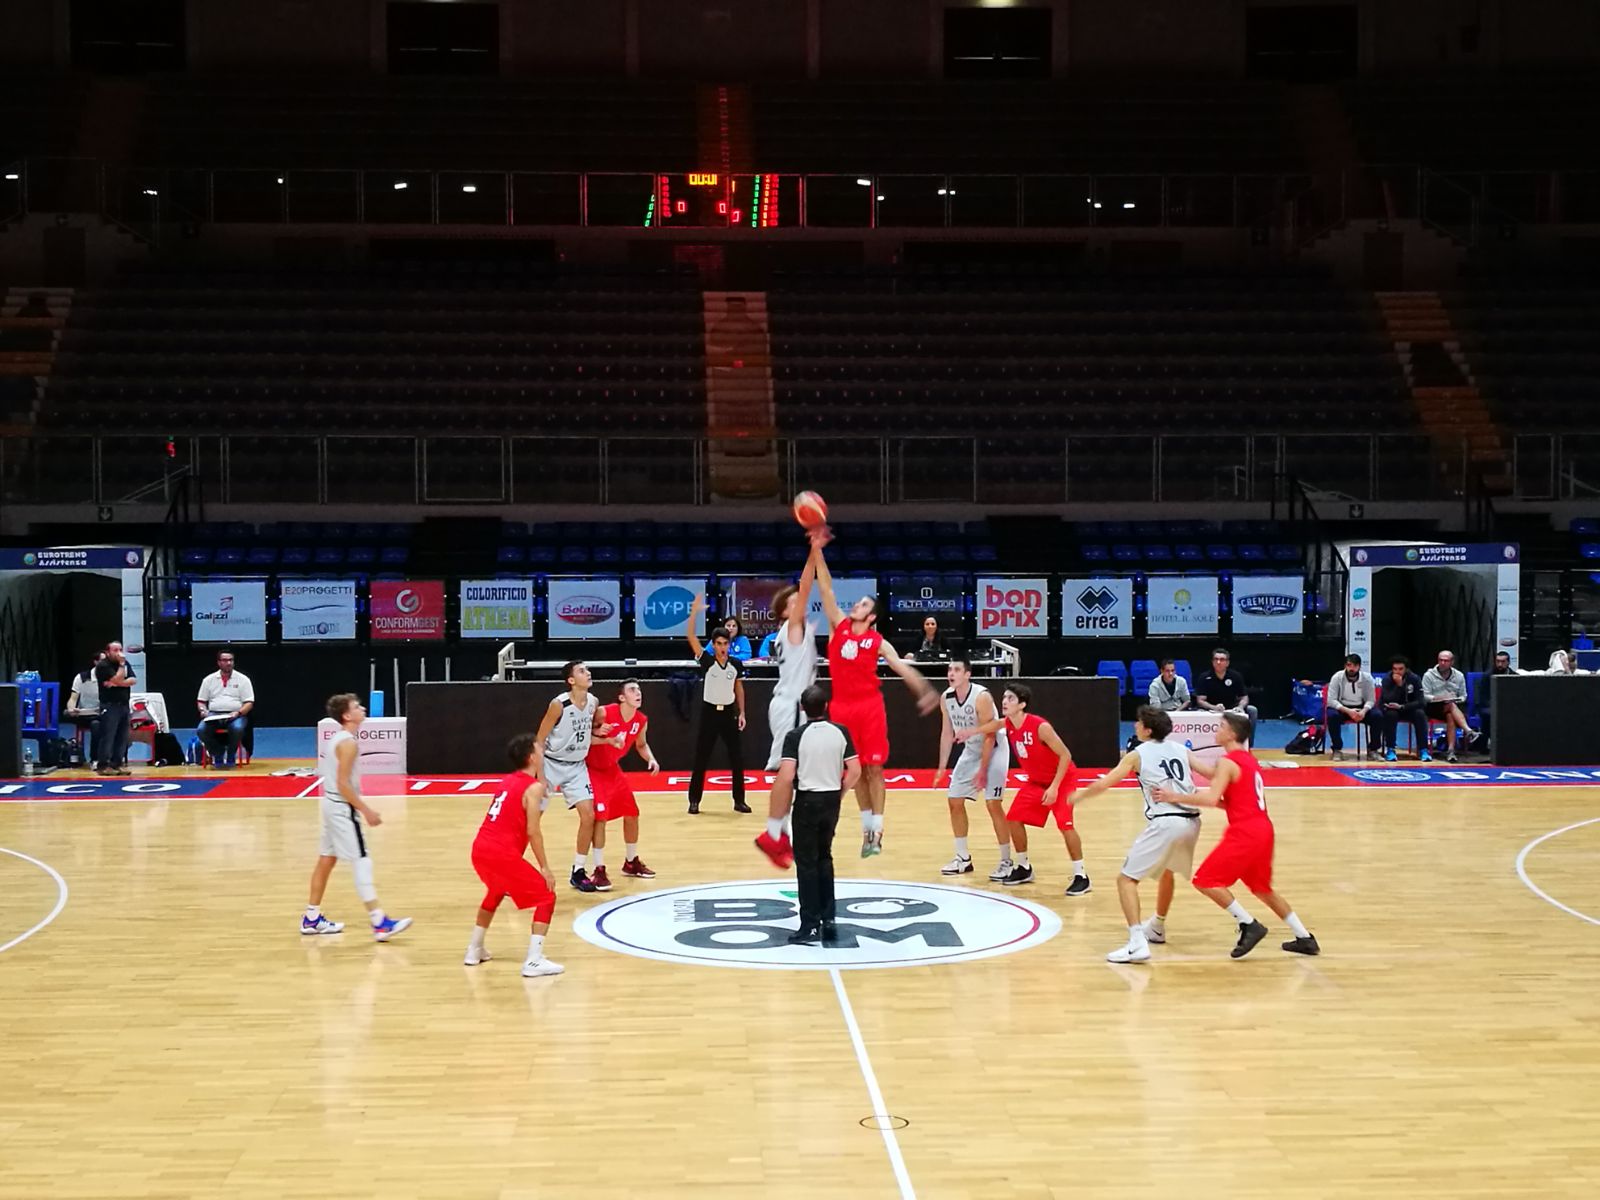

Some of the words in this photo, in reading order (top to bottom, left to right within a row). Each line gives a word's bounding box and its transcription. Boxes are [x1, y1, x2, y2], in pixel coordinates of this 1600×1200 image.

[1420, 554, 1467, 562] Assistenza
[466, 587, 527, 601] COLORIFICIO
[986, 584, 1042, 608] bon
[1240, 596, 1296, 608] CREMINELLI
[982, 609, 1040, 630] prix
[1075, 615, 1119, 629] errea
[575, 731, 585, 743] 15
[1023, 731, 1034, 745] 15
[1158, 758, 1185, 782] 10
[1432, 770, 1600, 780] BAN
[993, 786, 1003, 797] 11
[488, 790, 508, 821] 4
